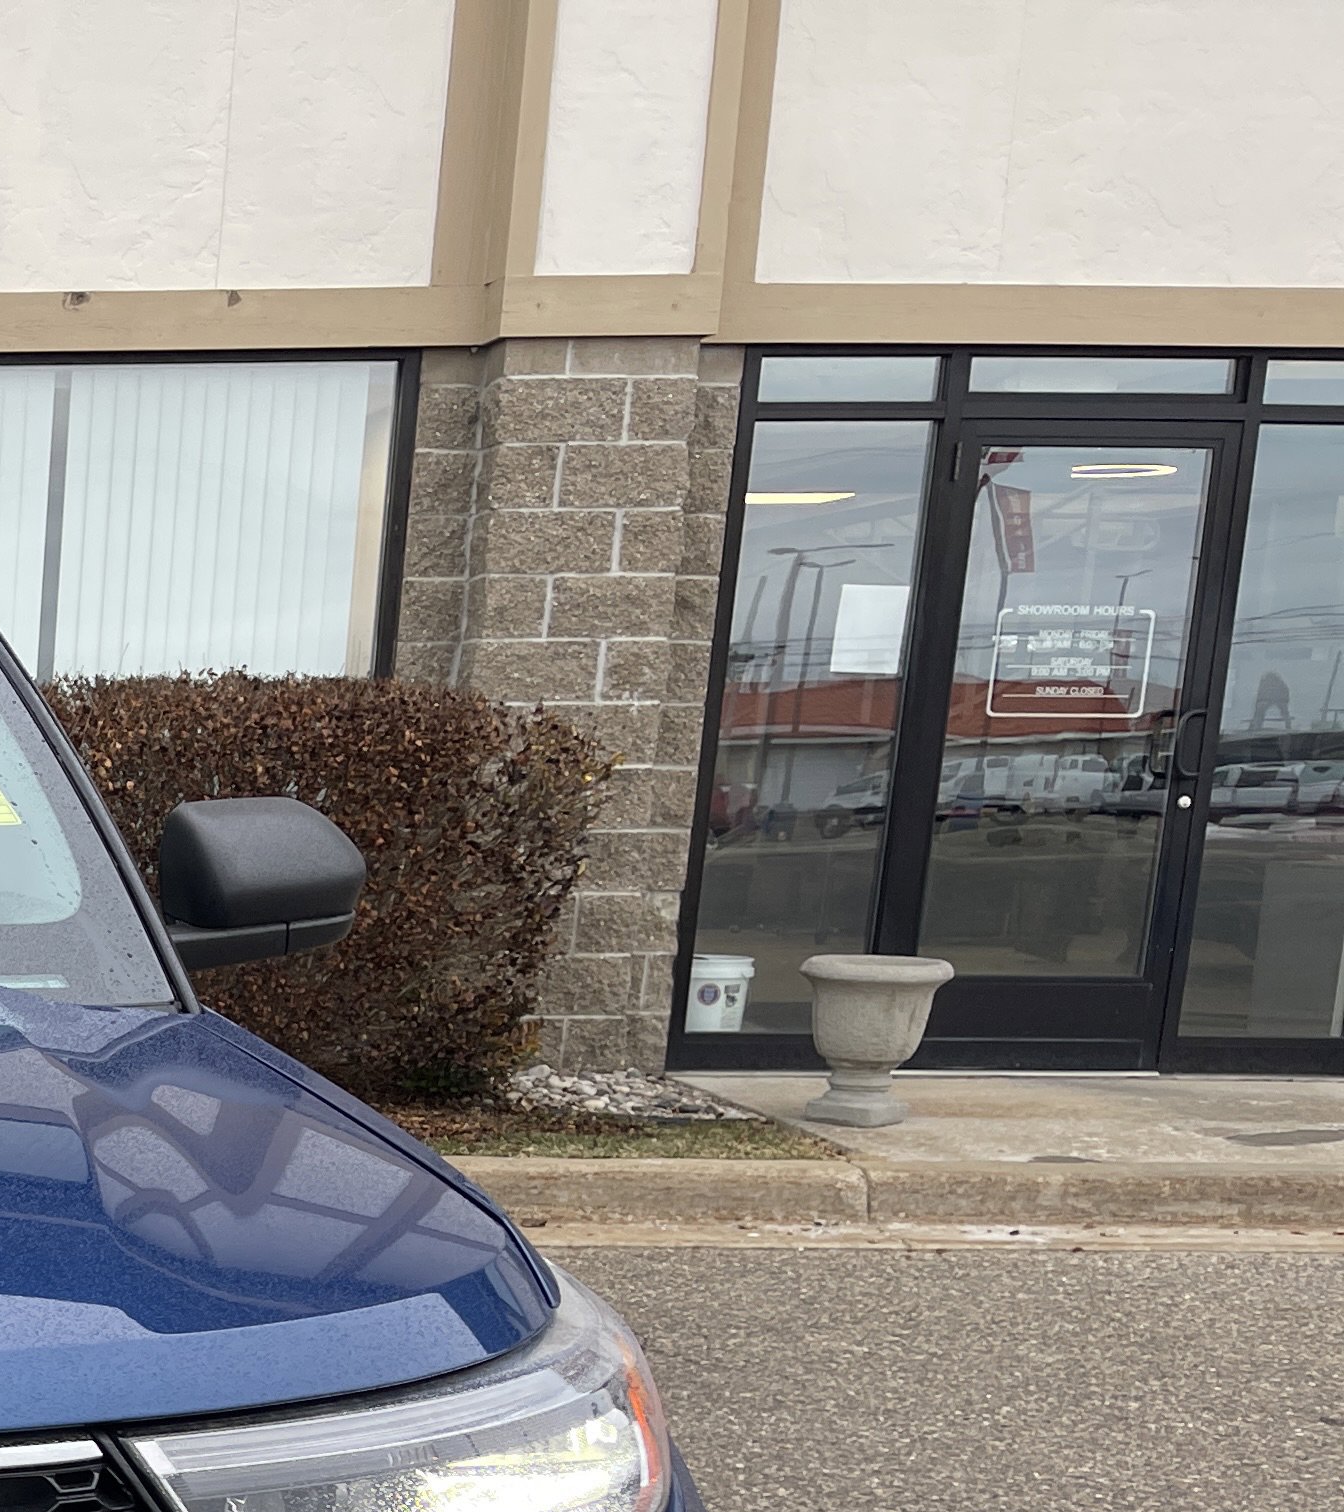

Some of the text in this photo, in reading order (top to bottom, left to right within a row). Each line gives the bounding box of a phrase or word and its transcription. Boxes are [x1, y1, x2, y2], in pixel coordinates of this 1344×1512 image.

[1017, 605, 1135, 616] SHOWROOM HOURS
[1035, 686, 1104, 696] SUNDAY CLOSED
